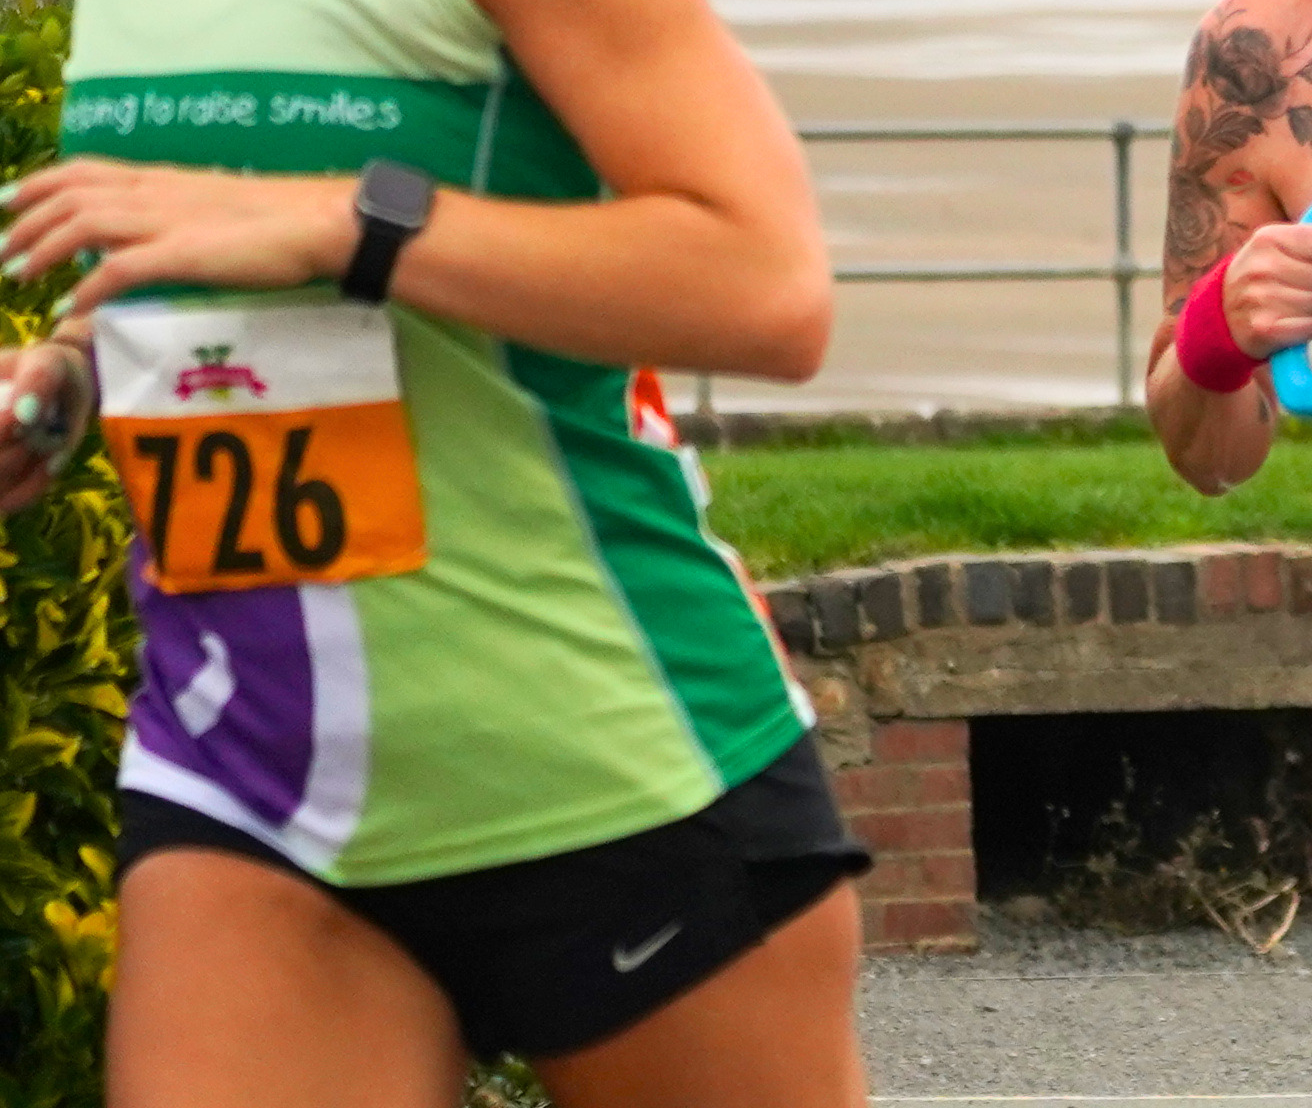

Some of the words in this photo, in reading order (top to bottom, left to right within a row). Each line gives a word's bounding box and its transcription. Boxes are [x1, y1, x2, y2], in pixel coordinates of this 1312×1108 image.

[142, 91, 176, 126] to
[177, 91, 258, 127] raise
[268, 90, 402, 131] smiles
[132, 426, 348, 576] 726
